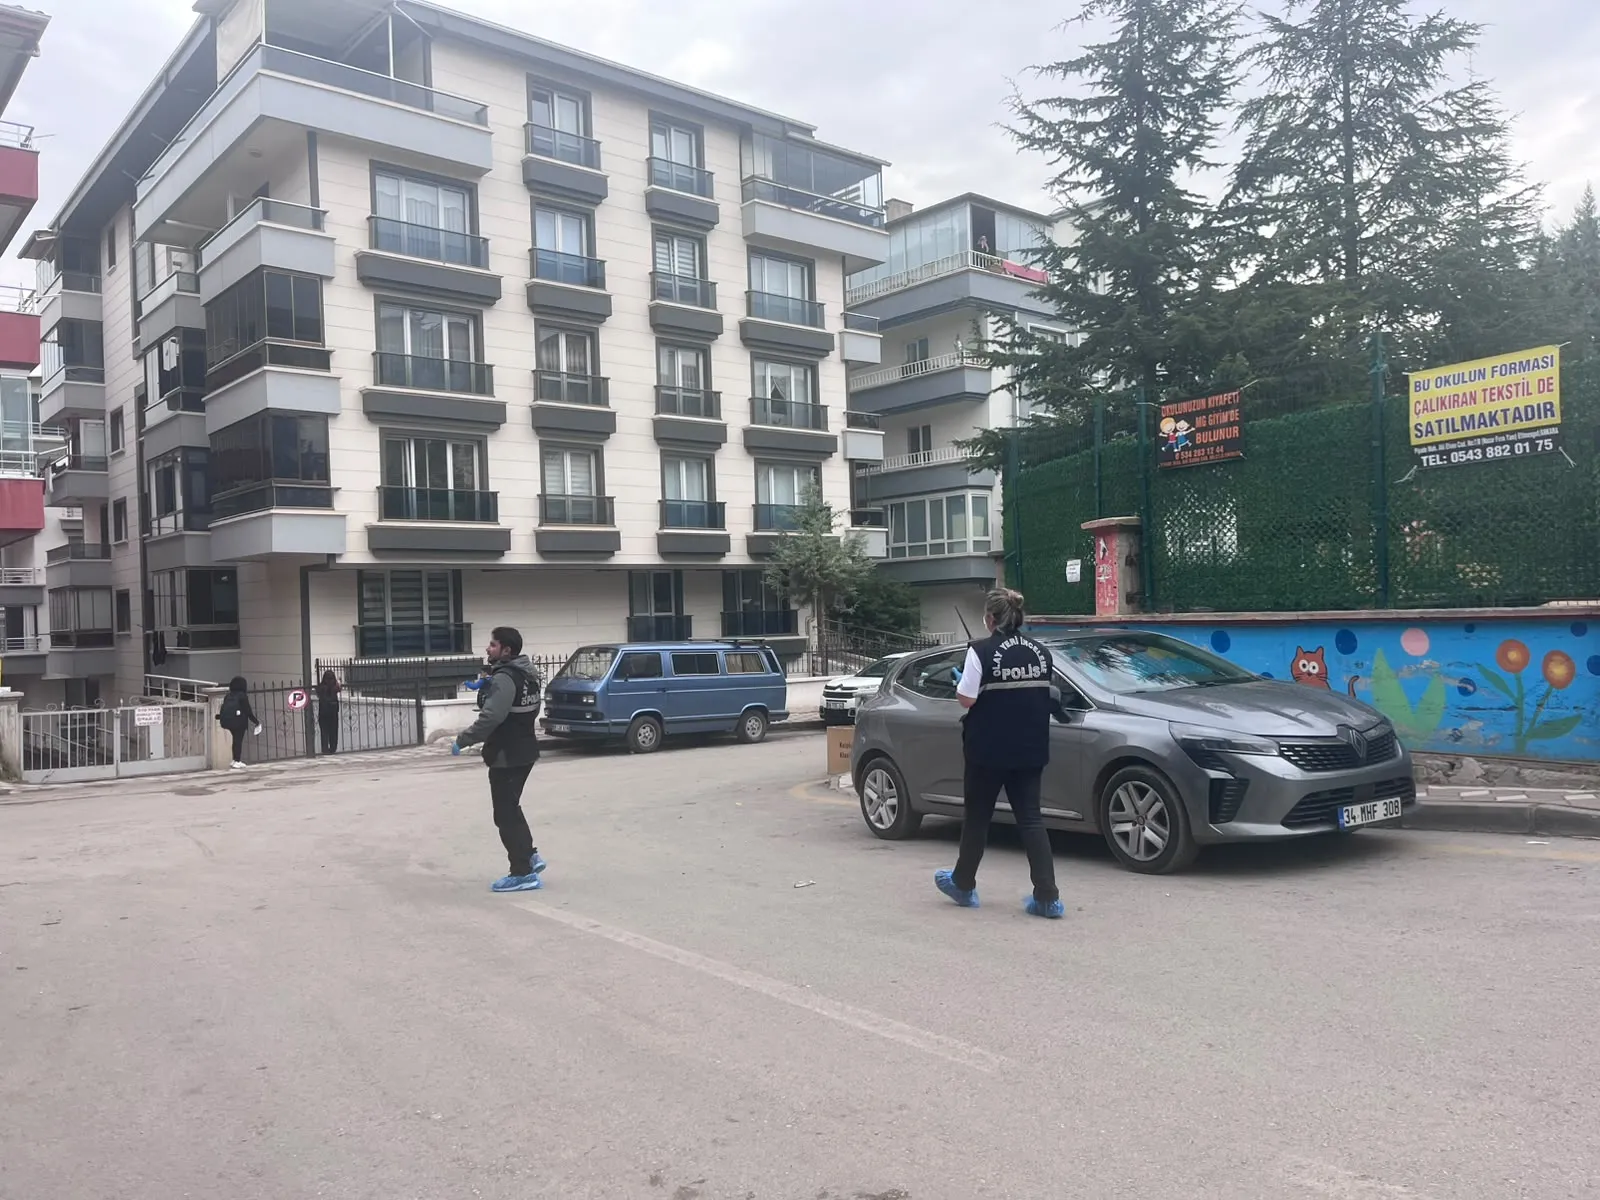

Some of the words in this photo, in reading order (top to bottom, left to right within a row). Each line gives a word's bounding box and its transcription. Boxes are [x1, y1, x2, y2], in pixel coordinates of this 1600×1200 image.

[1414, 378, 1431, 393] BU
[1435, 367, 1486, 389] OKULUN
[1491, 354, 1554, 379] FORMASI
[1161, 398, 1206, 417] OKULUNUZUN
[1414, 389, 1477, 418] ÇALIKIRAN
[1481, 377, 1533, 404] TEKSTİL
[1537, 376, 1554, 395] DE
[1414, 401, 1556, 439] SATILMAKTADIR
[1195, 426, 1239, 444] BULUNUR
[1421, 454, 1448, 467] TEL:
[1450, 448, 1482, 463] 0543
[1486, 444, 1511, 458] 882
[1514, 441, 1530, 455] 01
[1535, 438, 1553, 452] 75
[992, 651, 1003, 677] OLAY
[1000, 636, 1019, 650] YERİ
[1002, 664, 1041, 680] POLİS
[1344, 808, 1356, 824] 34
[1360, 803, 1378, 822] MHF
[1383, 800, 1399, 817] 308
